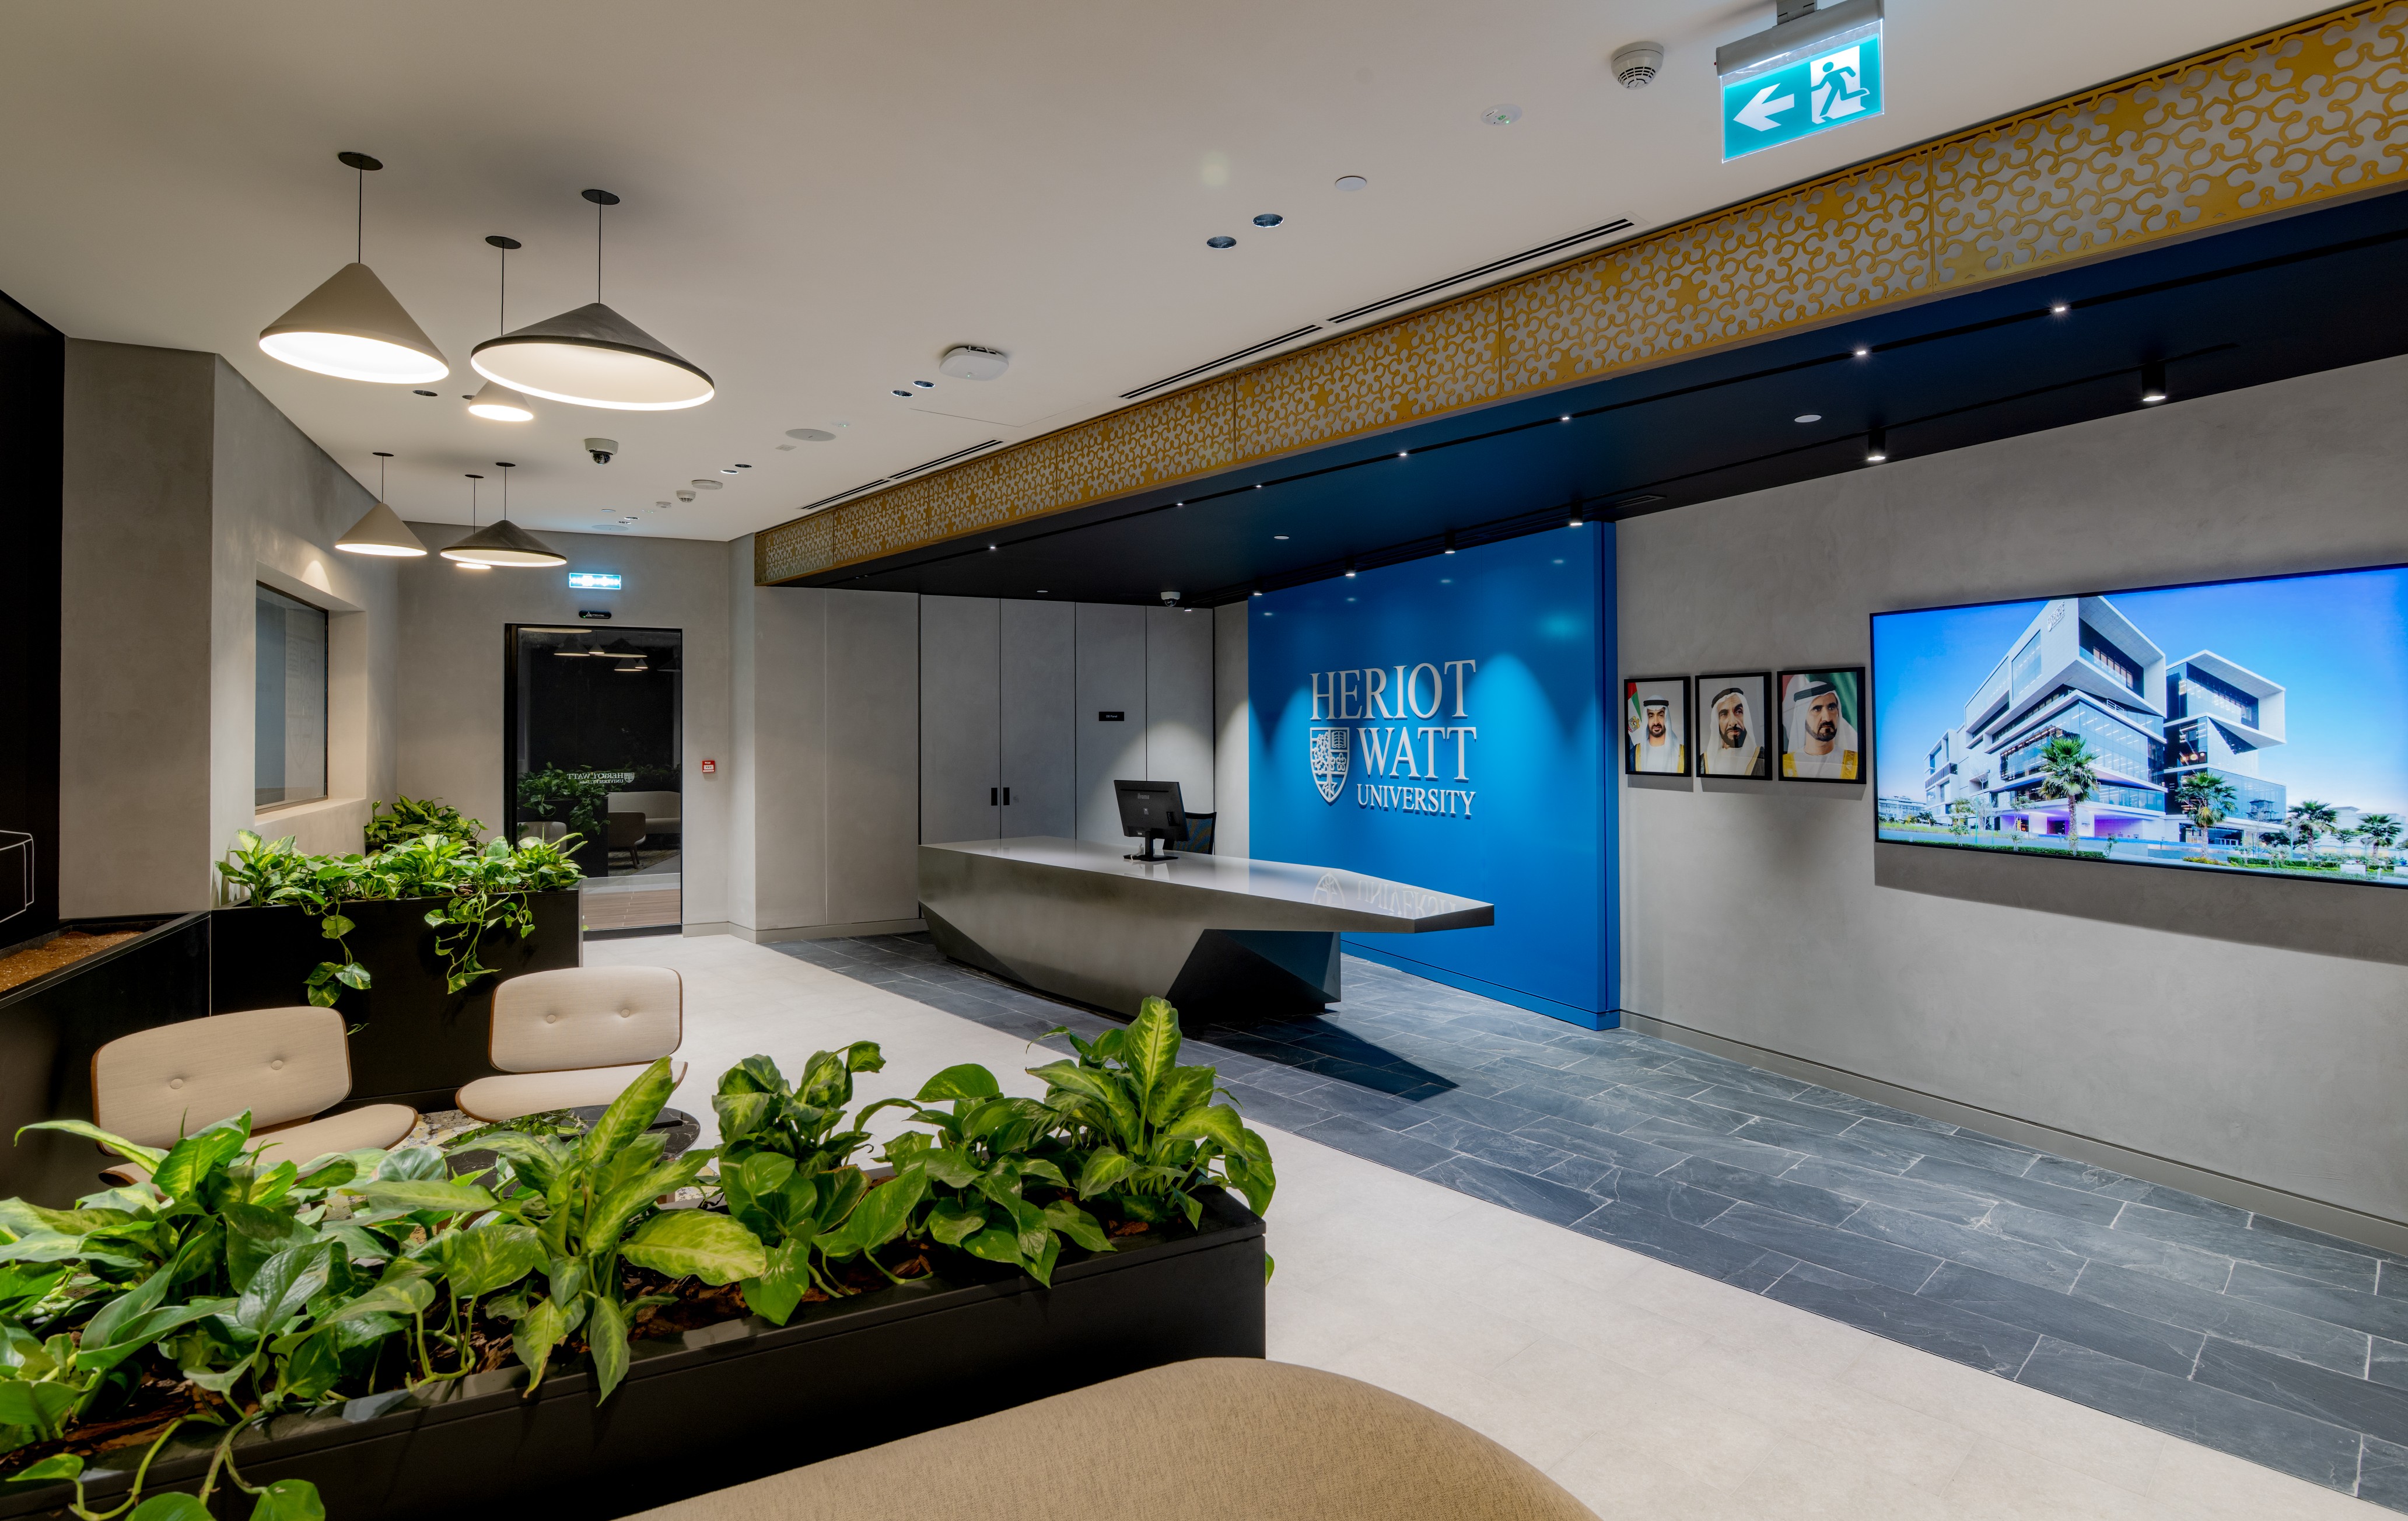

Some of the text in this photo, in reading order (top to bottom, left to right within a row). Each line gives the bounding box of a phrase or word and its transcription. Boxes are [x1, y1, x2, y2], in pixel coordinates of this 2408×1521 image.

[1309, 659, 1476, 720] HERIOT
[1356, 726, 1477, 781] WATT
[1356, 784, 1476, 816] UNIVERSITY
